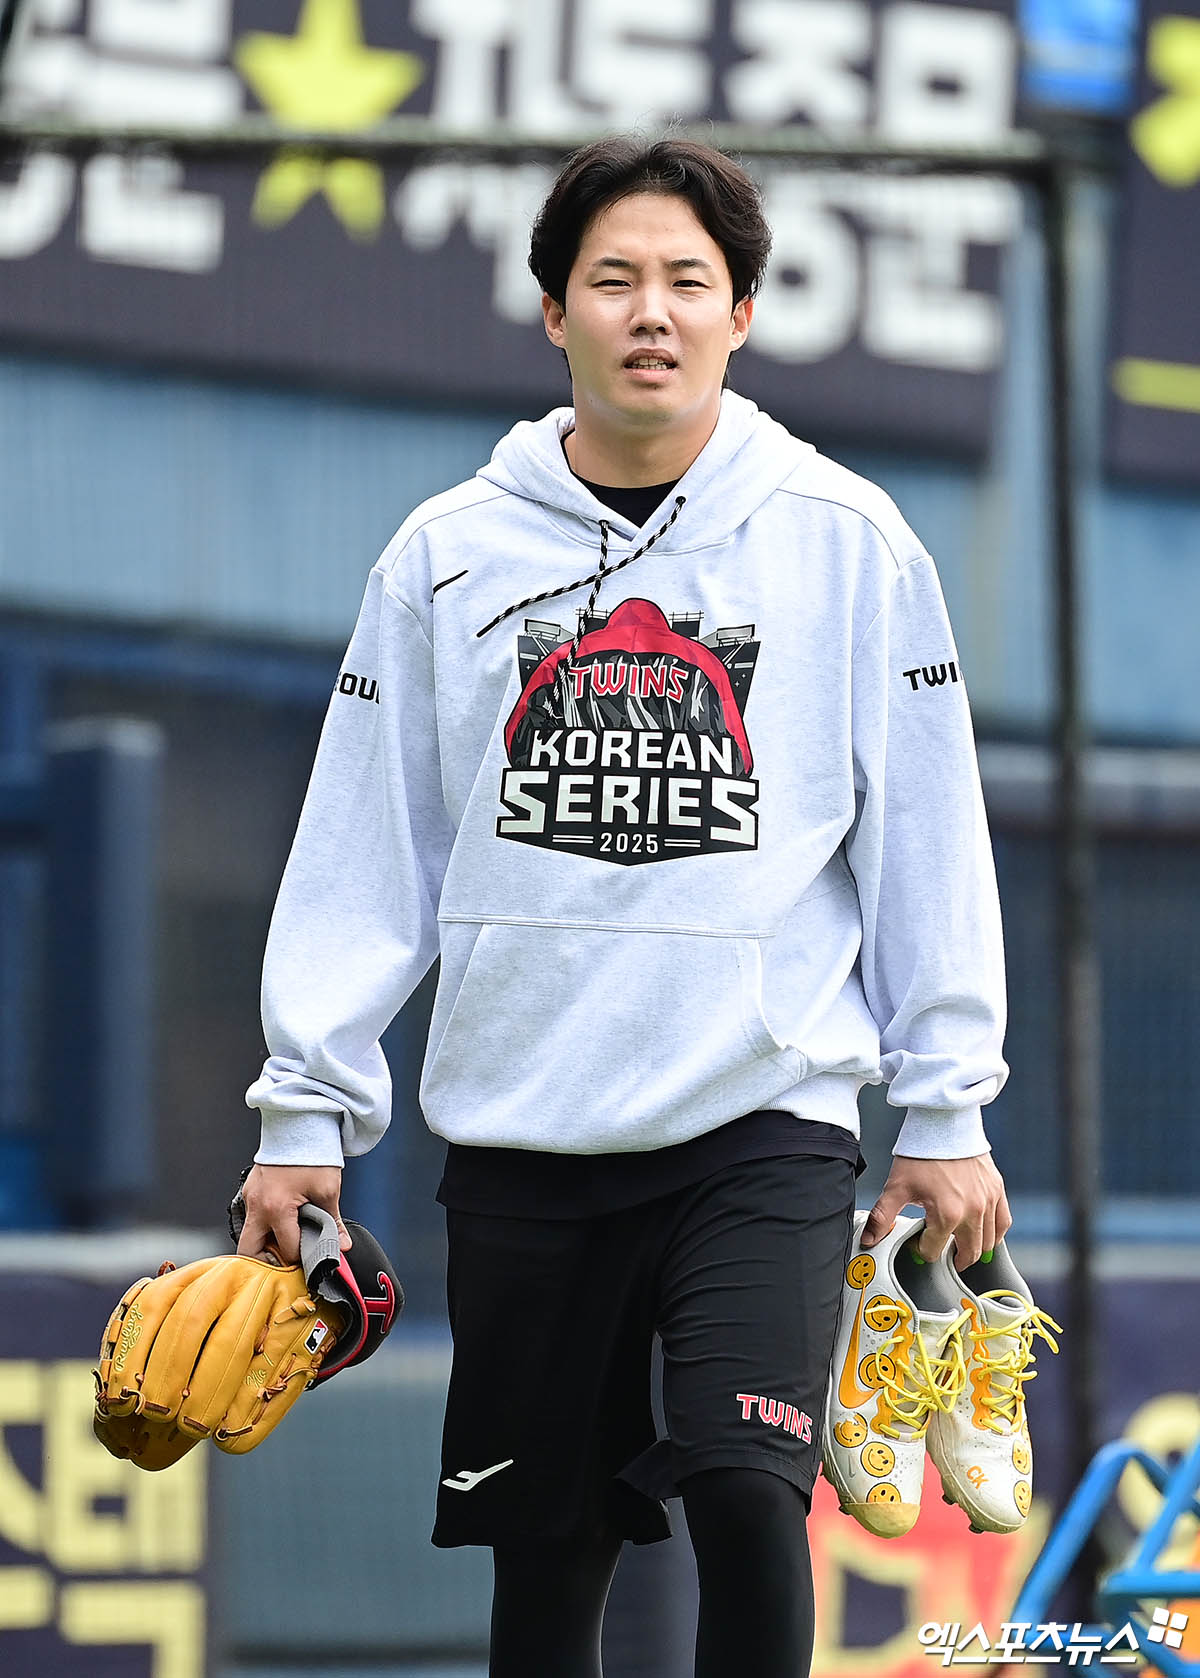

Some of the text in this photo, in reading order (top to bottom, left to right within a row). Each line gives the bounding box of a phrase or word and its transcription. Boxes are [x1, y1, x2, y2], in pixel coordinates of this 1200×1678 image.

[335, 671, 380, 705] OU
[568, 662, 689, 704] TWINS
[902, 661, 962, 691] TWI
[530, 729, 734, 775] KOREAN
[499, 770, 757, 847] SERIES
[599, 832, 659, 854] 2025
[114, 1303, 144, 1372] Rawlings
[736, 1393, 813, 1445] TWINS
[967, 1465, 989, 1489] CK
